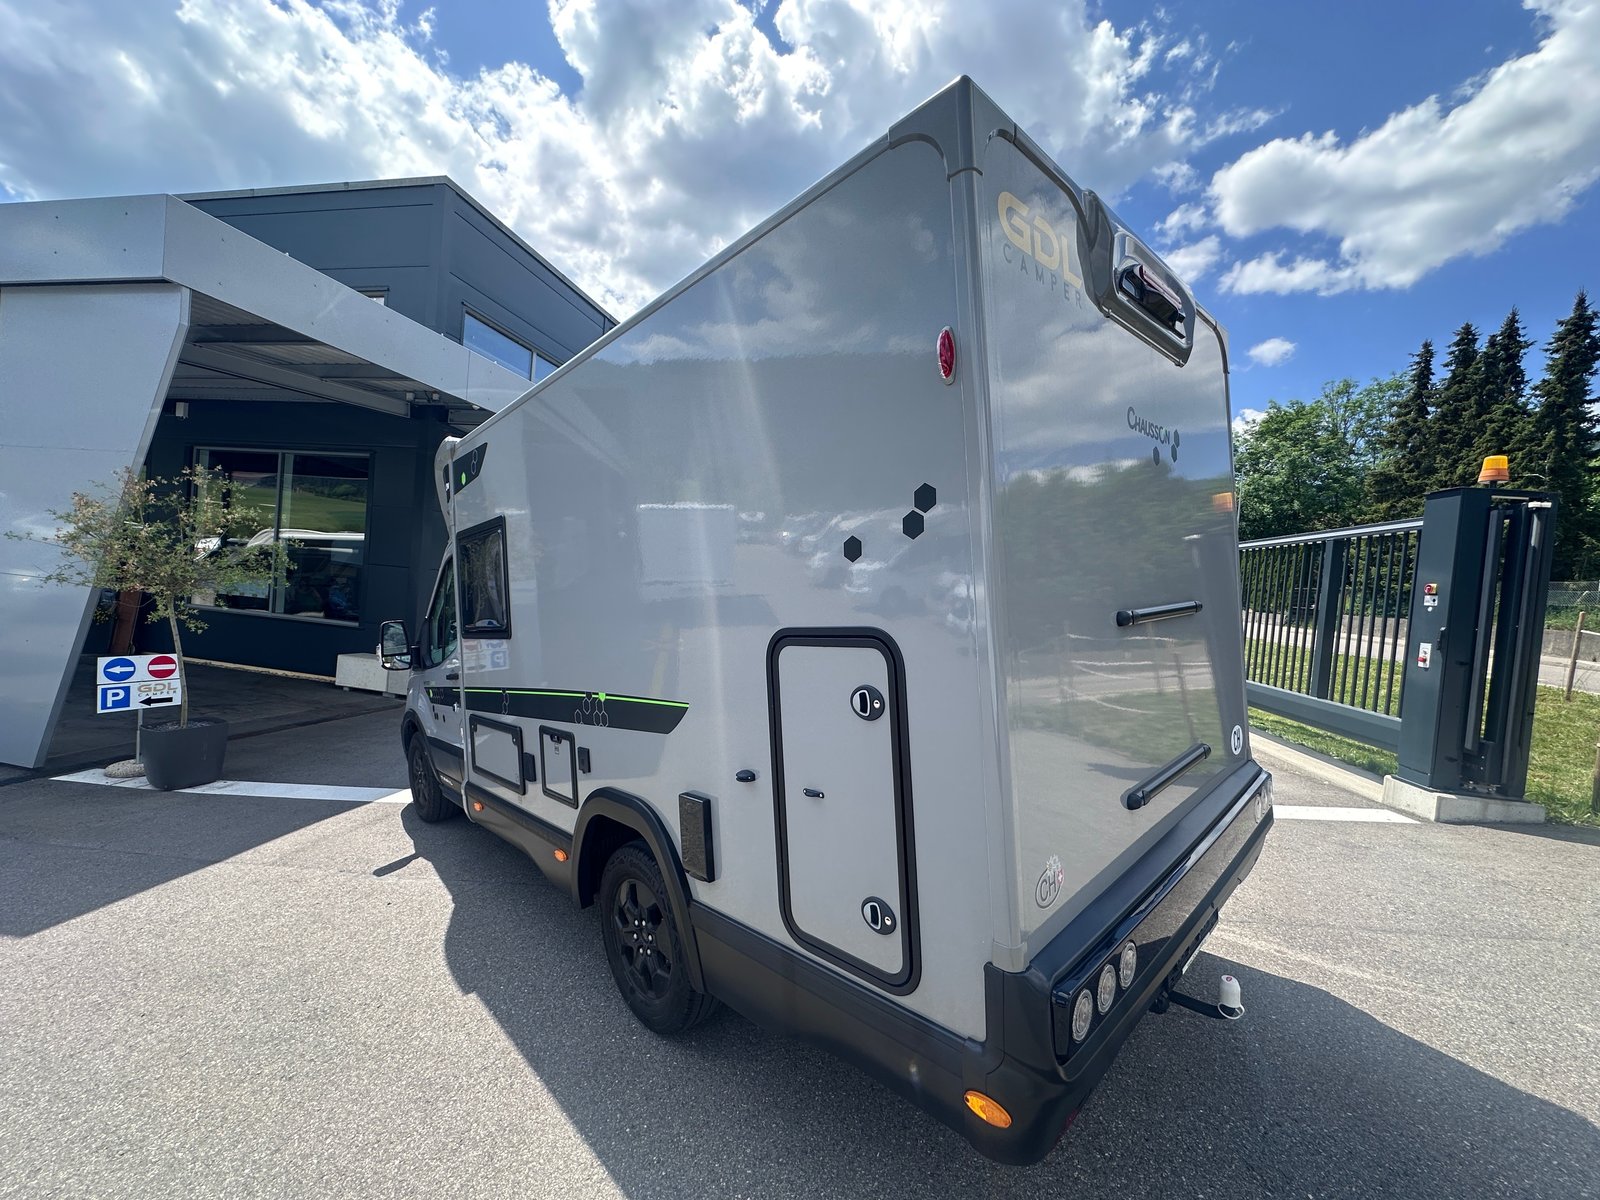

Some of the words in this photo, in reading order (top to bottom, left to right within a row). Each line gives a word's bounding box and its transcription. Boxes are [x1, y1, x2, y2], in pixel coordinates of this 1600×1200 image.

[998, 191, 1083, 289] GDL
[1002, 243, 1083, 309] CAMPER
[106, 688, 125, 708] P
[137, 682, 178, 693] GDL
[138, 690, 177, 698] CAMPER
[1040, 871, 1057, 902] CH
